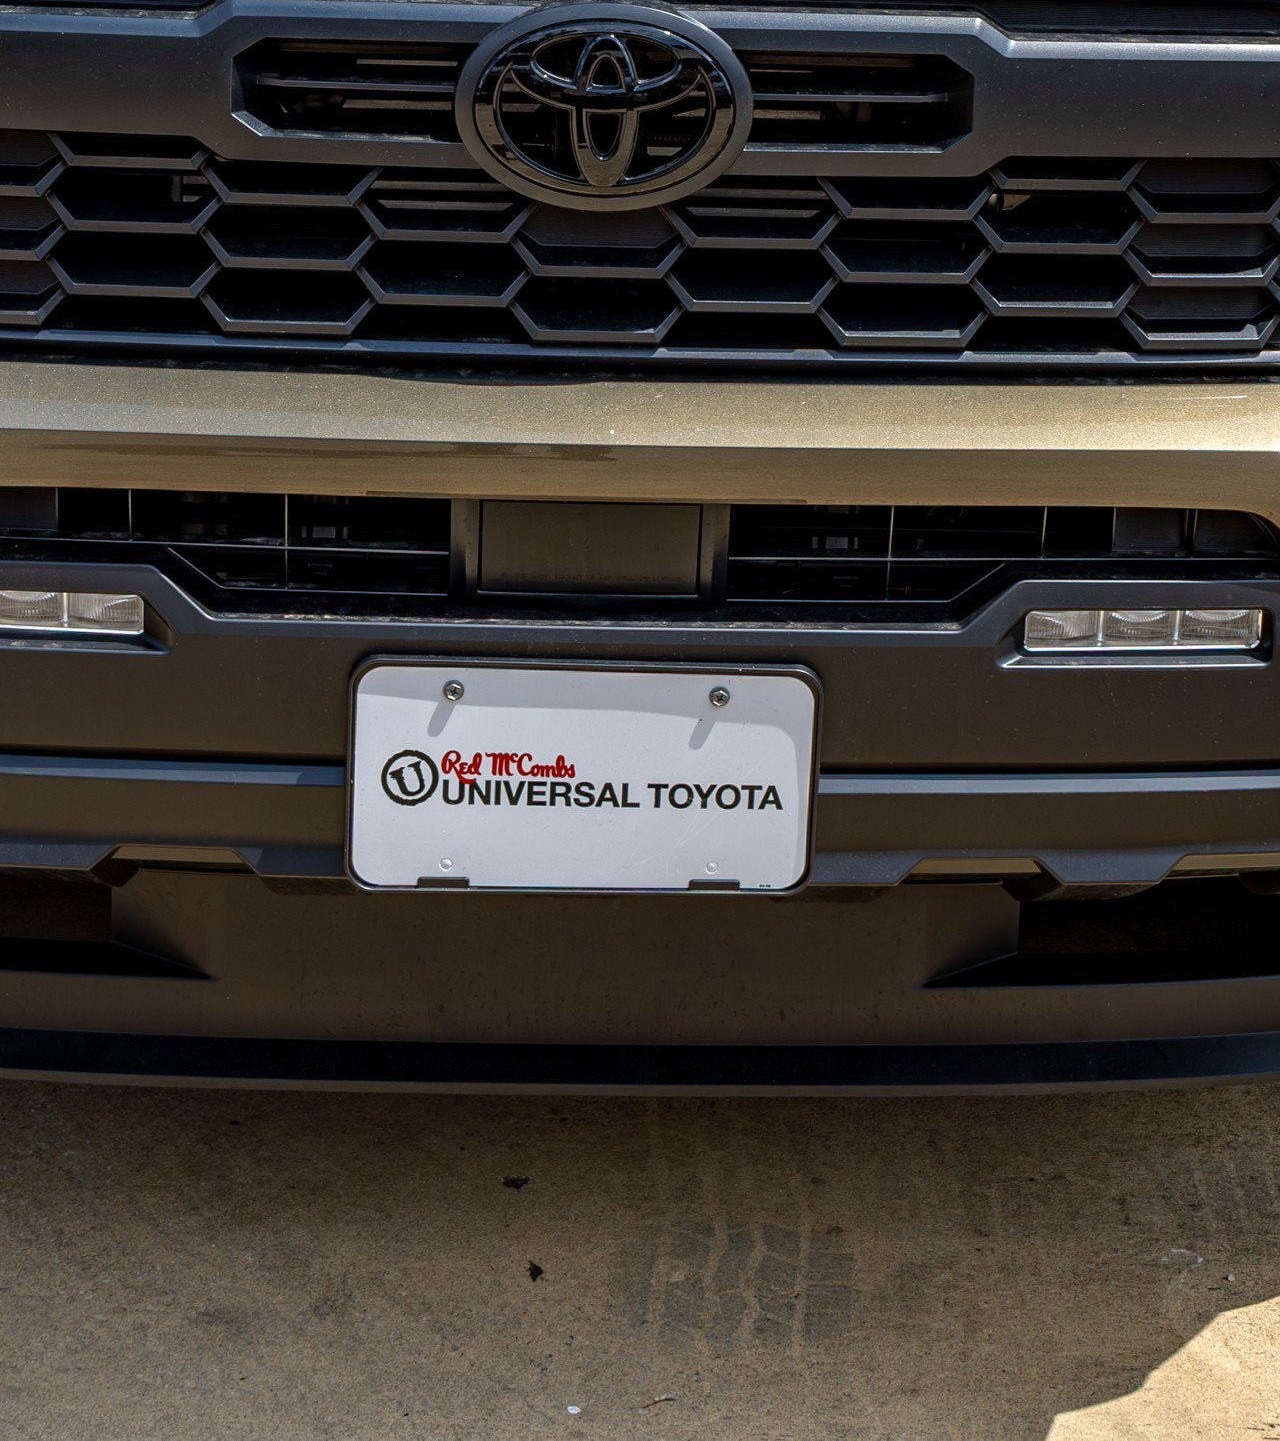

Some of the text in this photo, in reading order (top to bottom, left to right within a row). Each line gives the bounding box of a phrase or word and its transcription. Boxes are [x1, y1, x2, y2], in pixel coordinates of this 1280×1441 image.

[441, 750, 482, 784] Red
[442, 779, 784, 810] UNIVERSAL TOYOTA
